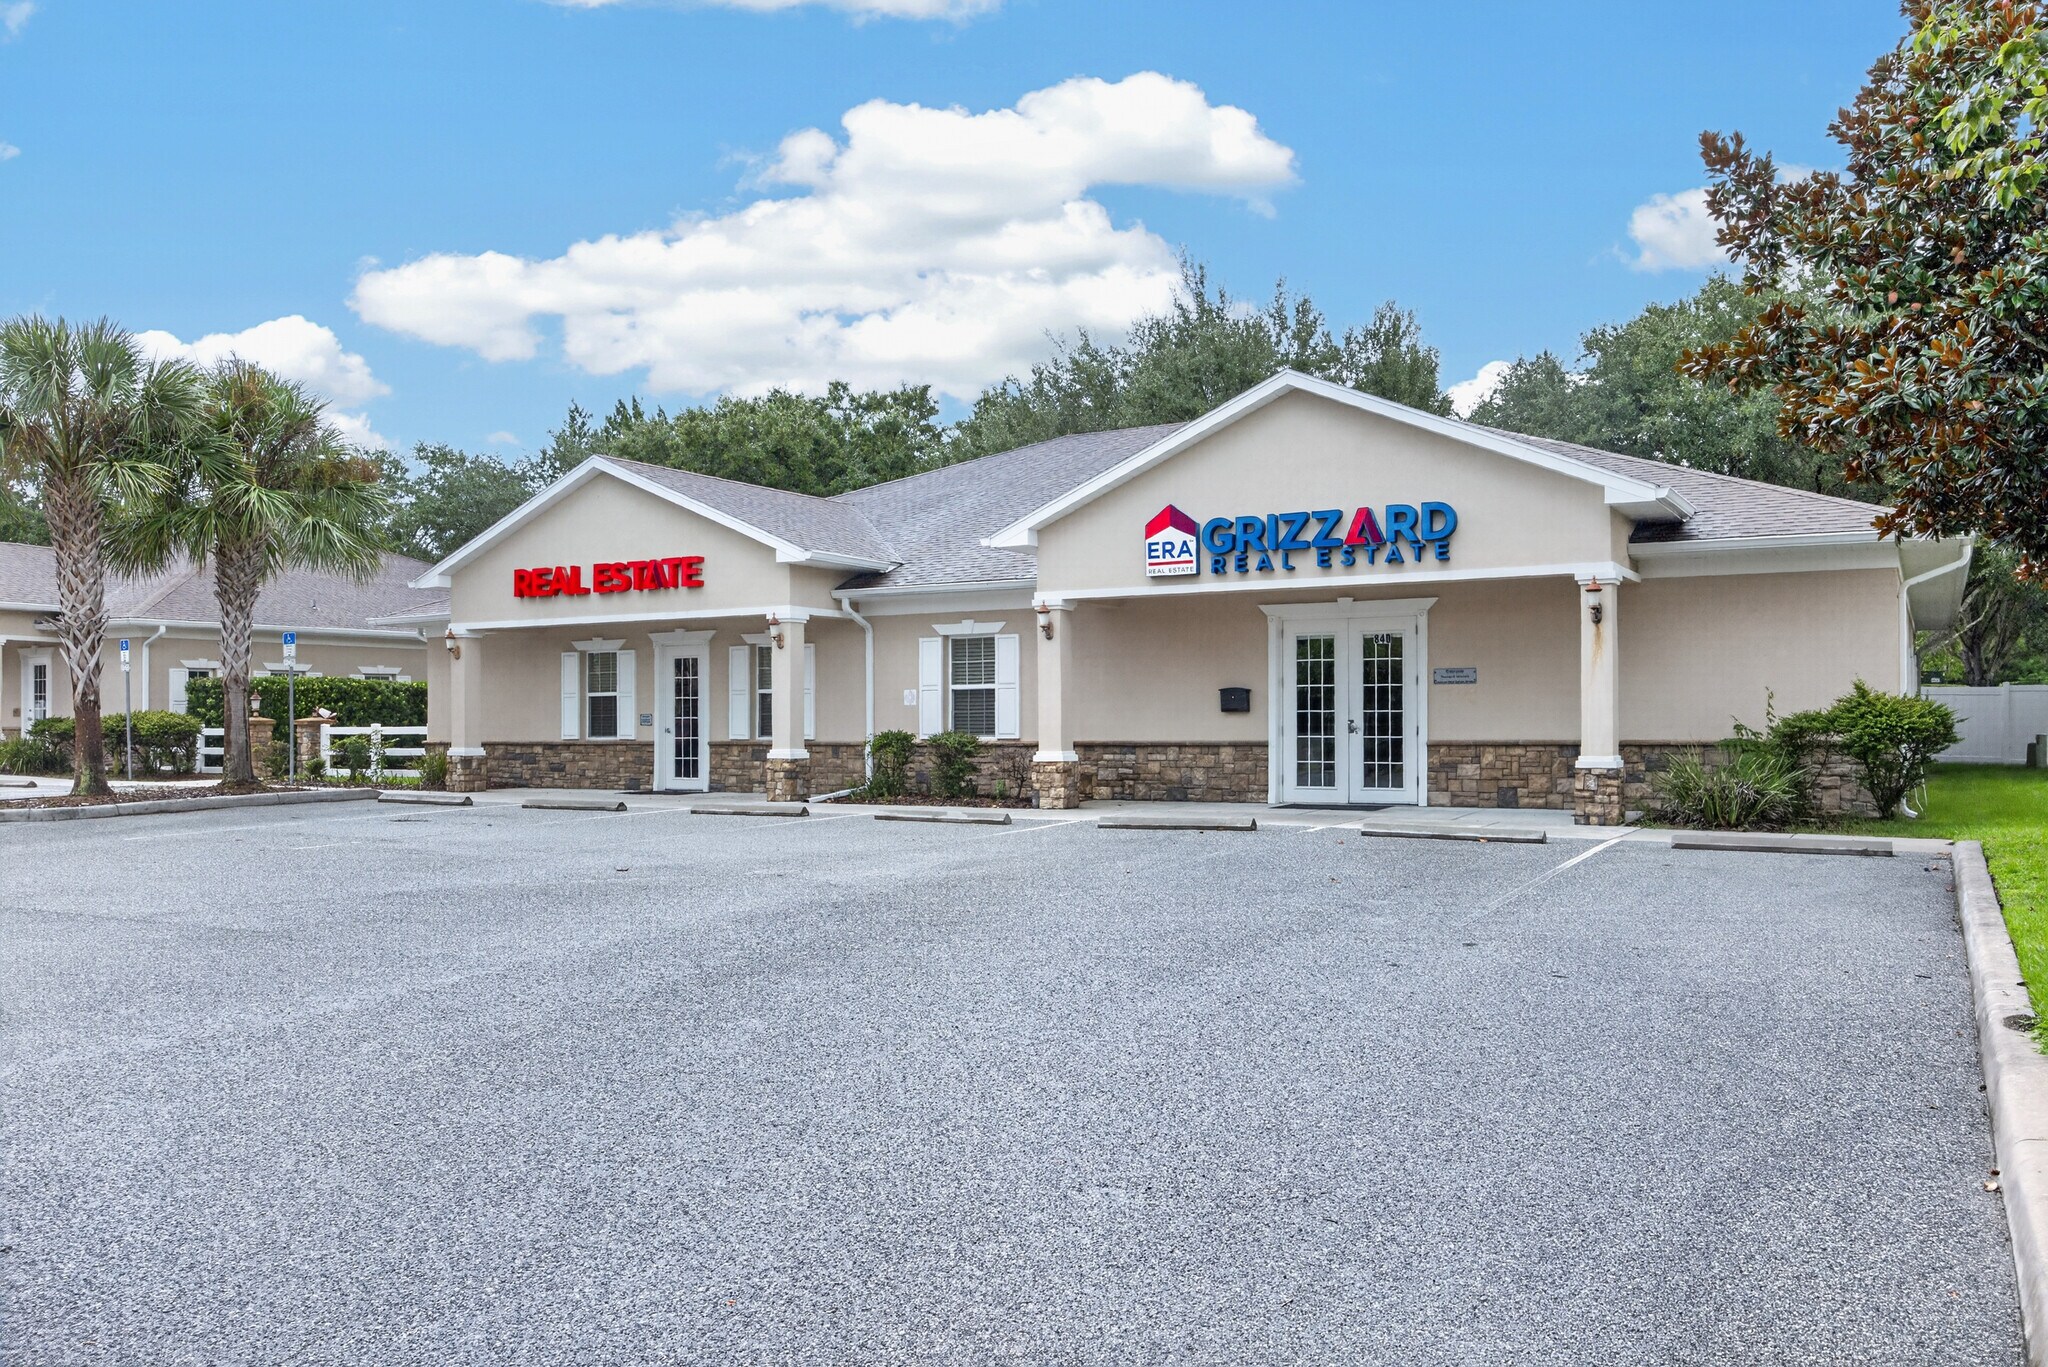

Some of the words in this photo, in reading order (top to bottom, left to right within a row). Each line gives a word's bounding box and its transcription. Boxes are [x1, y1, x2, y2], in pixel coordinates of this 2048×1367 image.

[1202, 501, 1458, 555] GRIZZARD
[1148, 540, 1193, 559] ERA
[1210, 552, 1296, 574] REAL
[1316, 541, 1450, 568] ESTATE
[513, 565, 591, 598] REAL
[593, 556, 704, 593] ESTATE
[1374, 633, 1391, 644] 840
